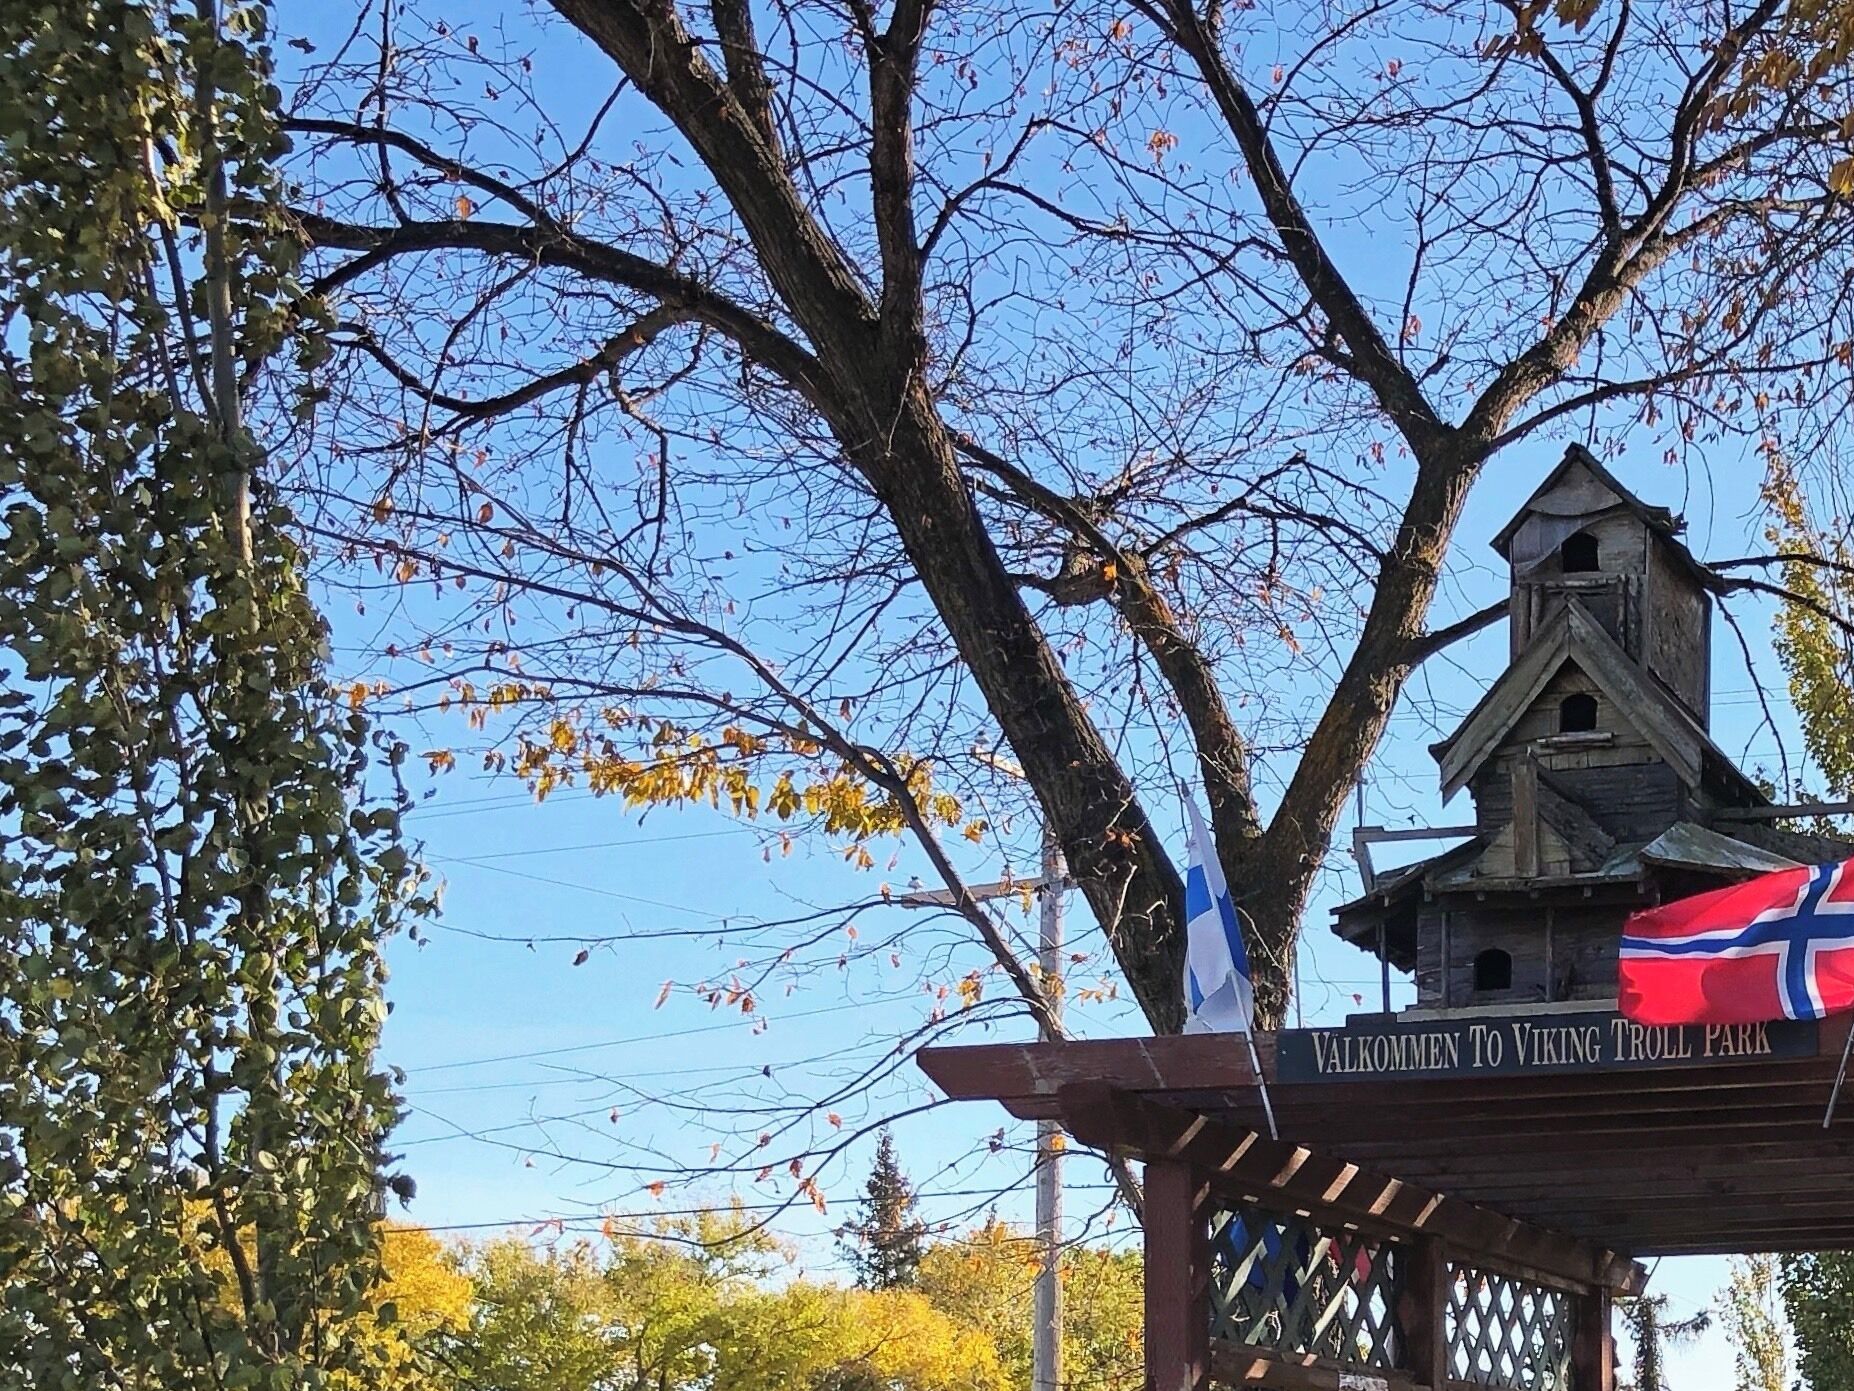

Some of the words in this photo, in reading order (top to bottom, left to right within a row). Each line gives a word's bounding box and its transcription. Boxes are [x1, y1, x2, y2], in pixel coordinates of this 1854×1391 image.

[1468, 1024, 1503, 1068] TO
[1511, 1022, 1602, 1066] VIKING
[1610, 1018, 1692, 1062] TROLL
[1703, 1020, 1772, 1058] PARK
